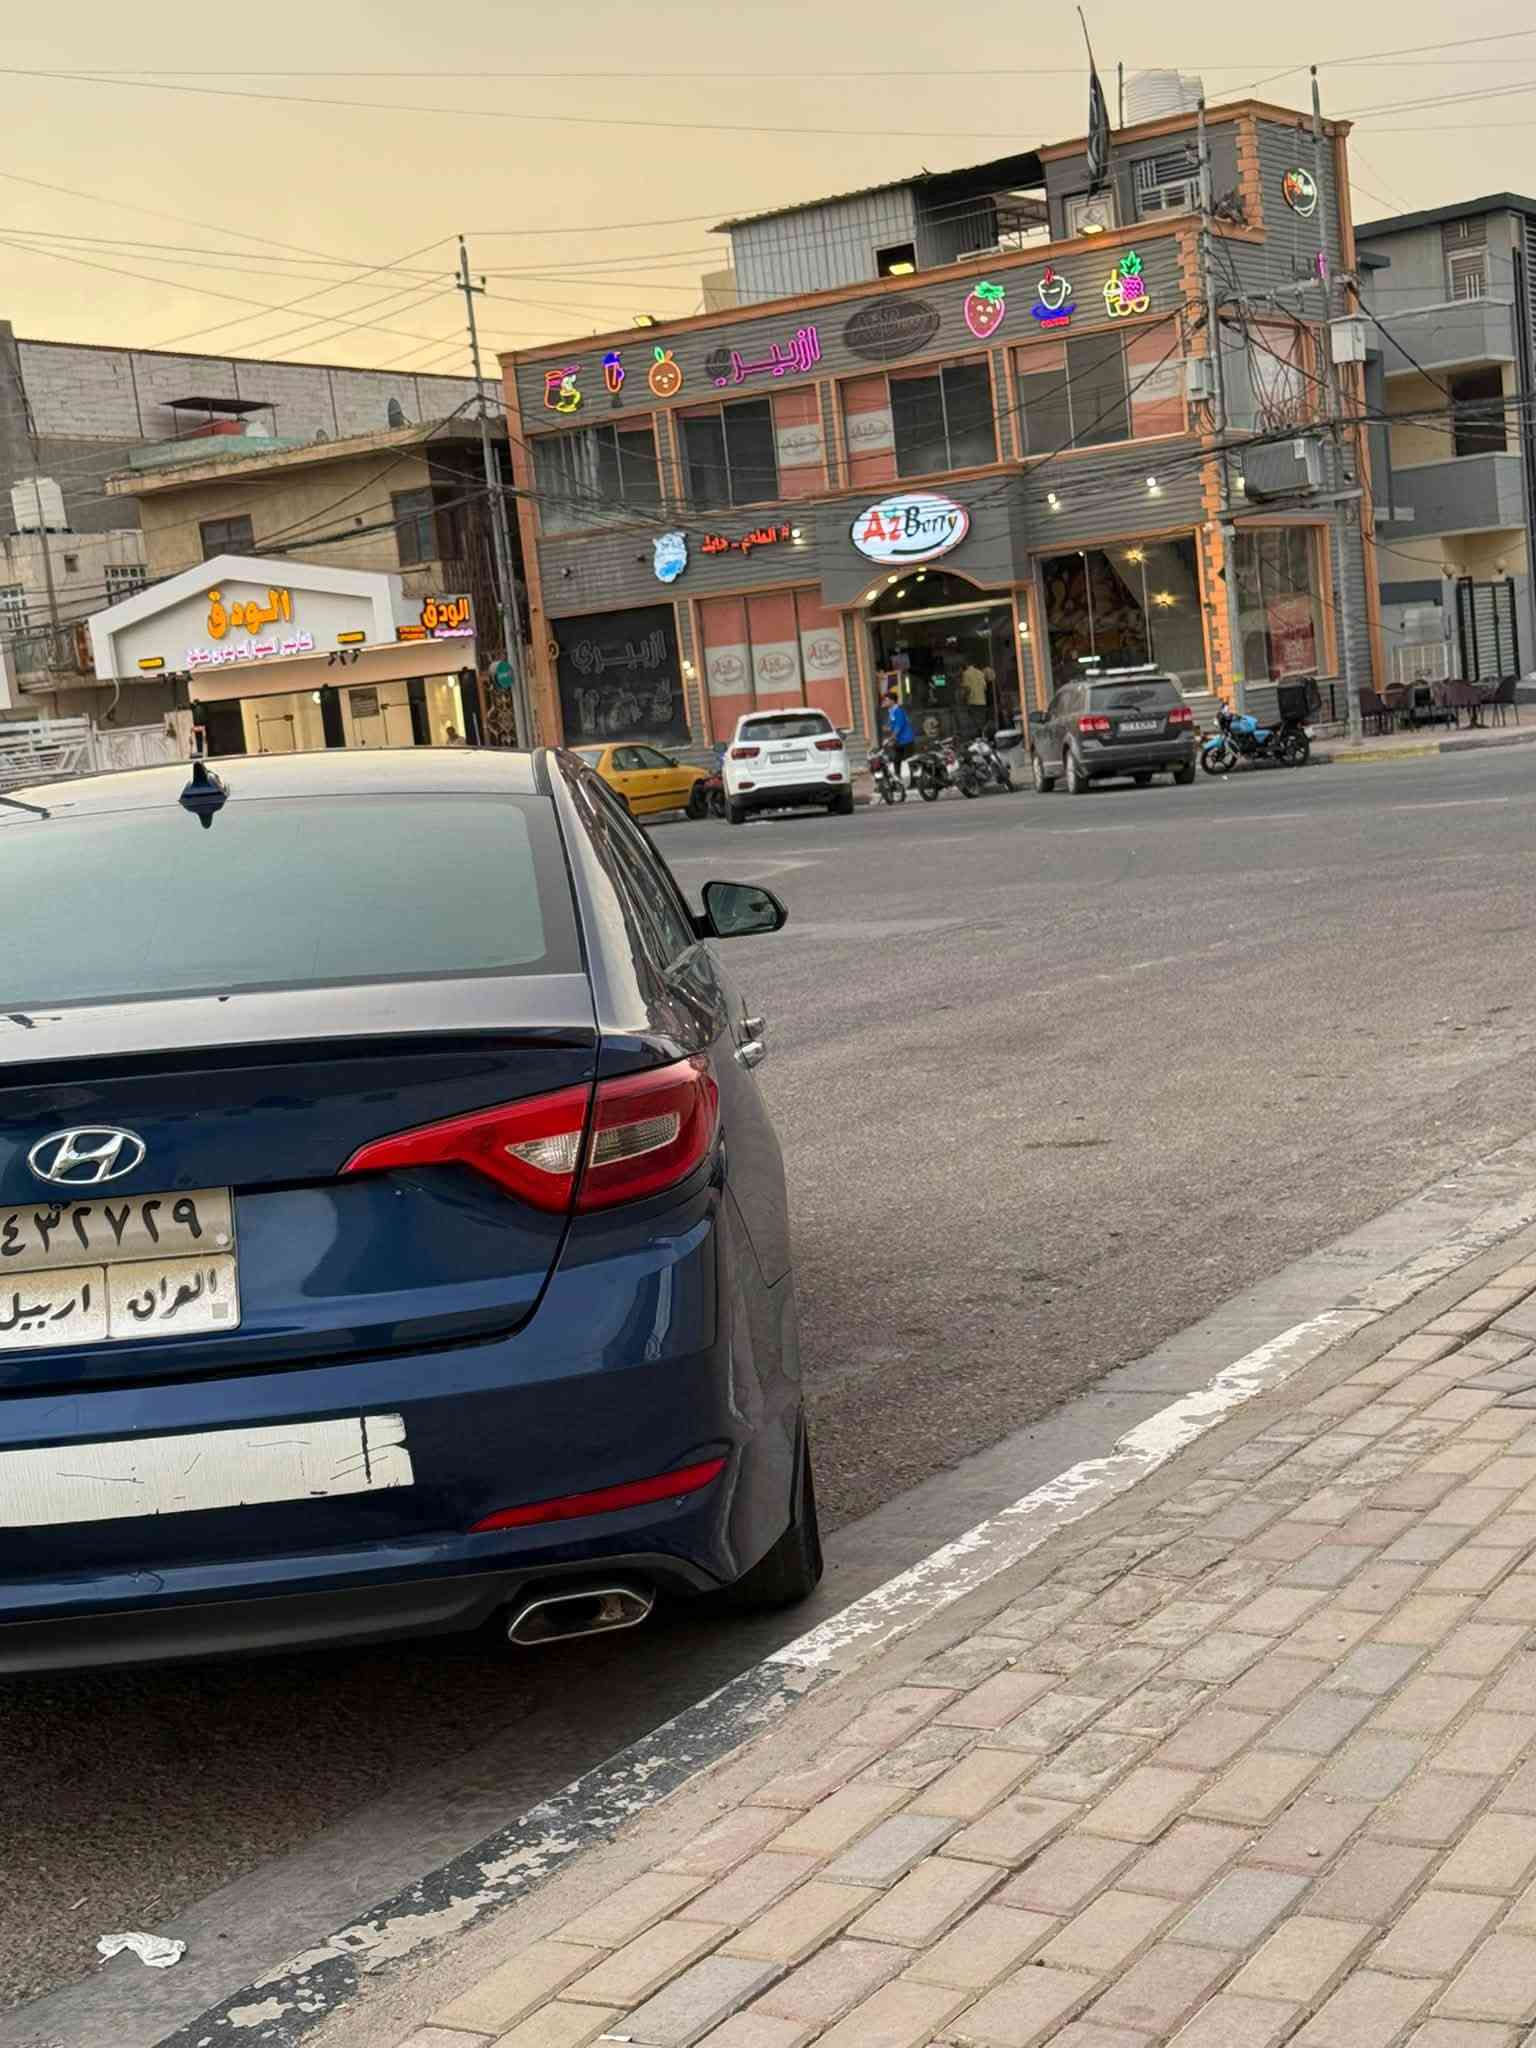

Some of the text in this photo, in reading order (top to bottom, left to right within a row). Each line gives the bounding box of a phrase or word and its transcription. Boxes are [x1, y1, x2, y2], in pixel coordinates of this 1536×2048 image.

[207, 588, 291, 640] الودق
[422, 597, 470, 629] الودق
[1, 1198, 203, 1257] ٤٣٢٧٢٩
[0, 1283, 91, 1331] اربيل
